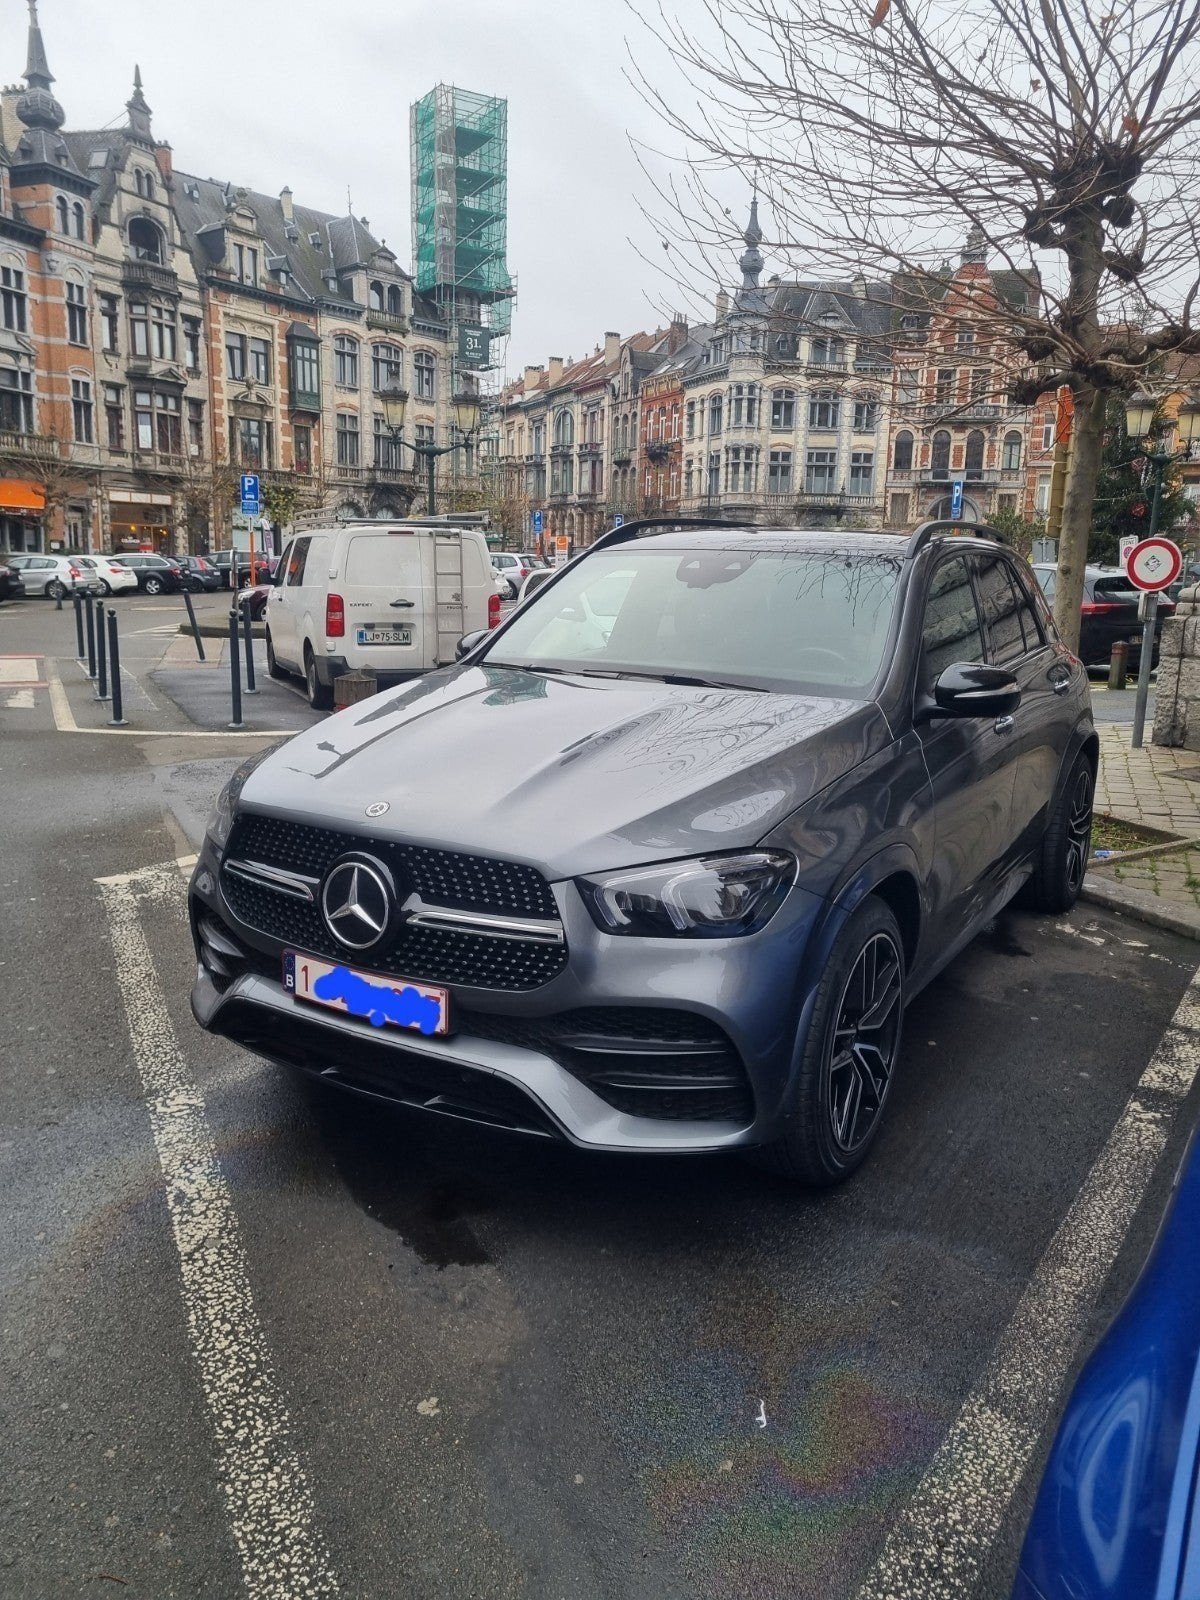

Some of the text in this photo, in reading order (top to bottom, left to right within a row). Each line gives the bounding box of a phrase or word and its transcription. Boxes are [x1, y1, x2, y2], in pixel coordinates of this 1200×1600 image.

[244, 477, 255, 491] P
[953, 485, 960, 504] P
[615, 517, 622, 527] P
[286, 973, 294, 987] B
